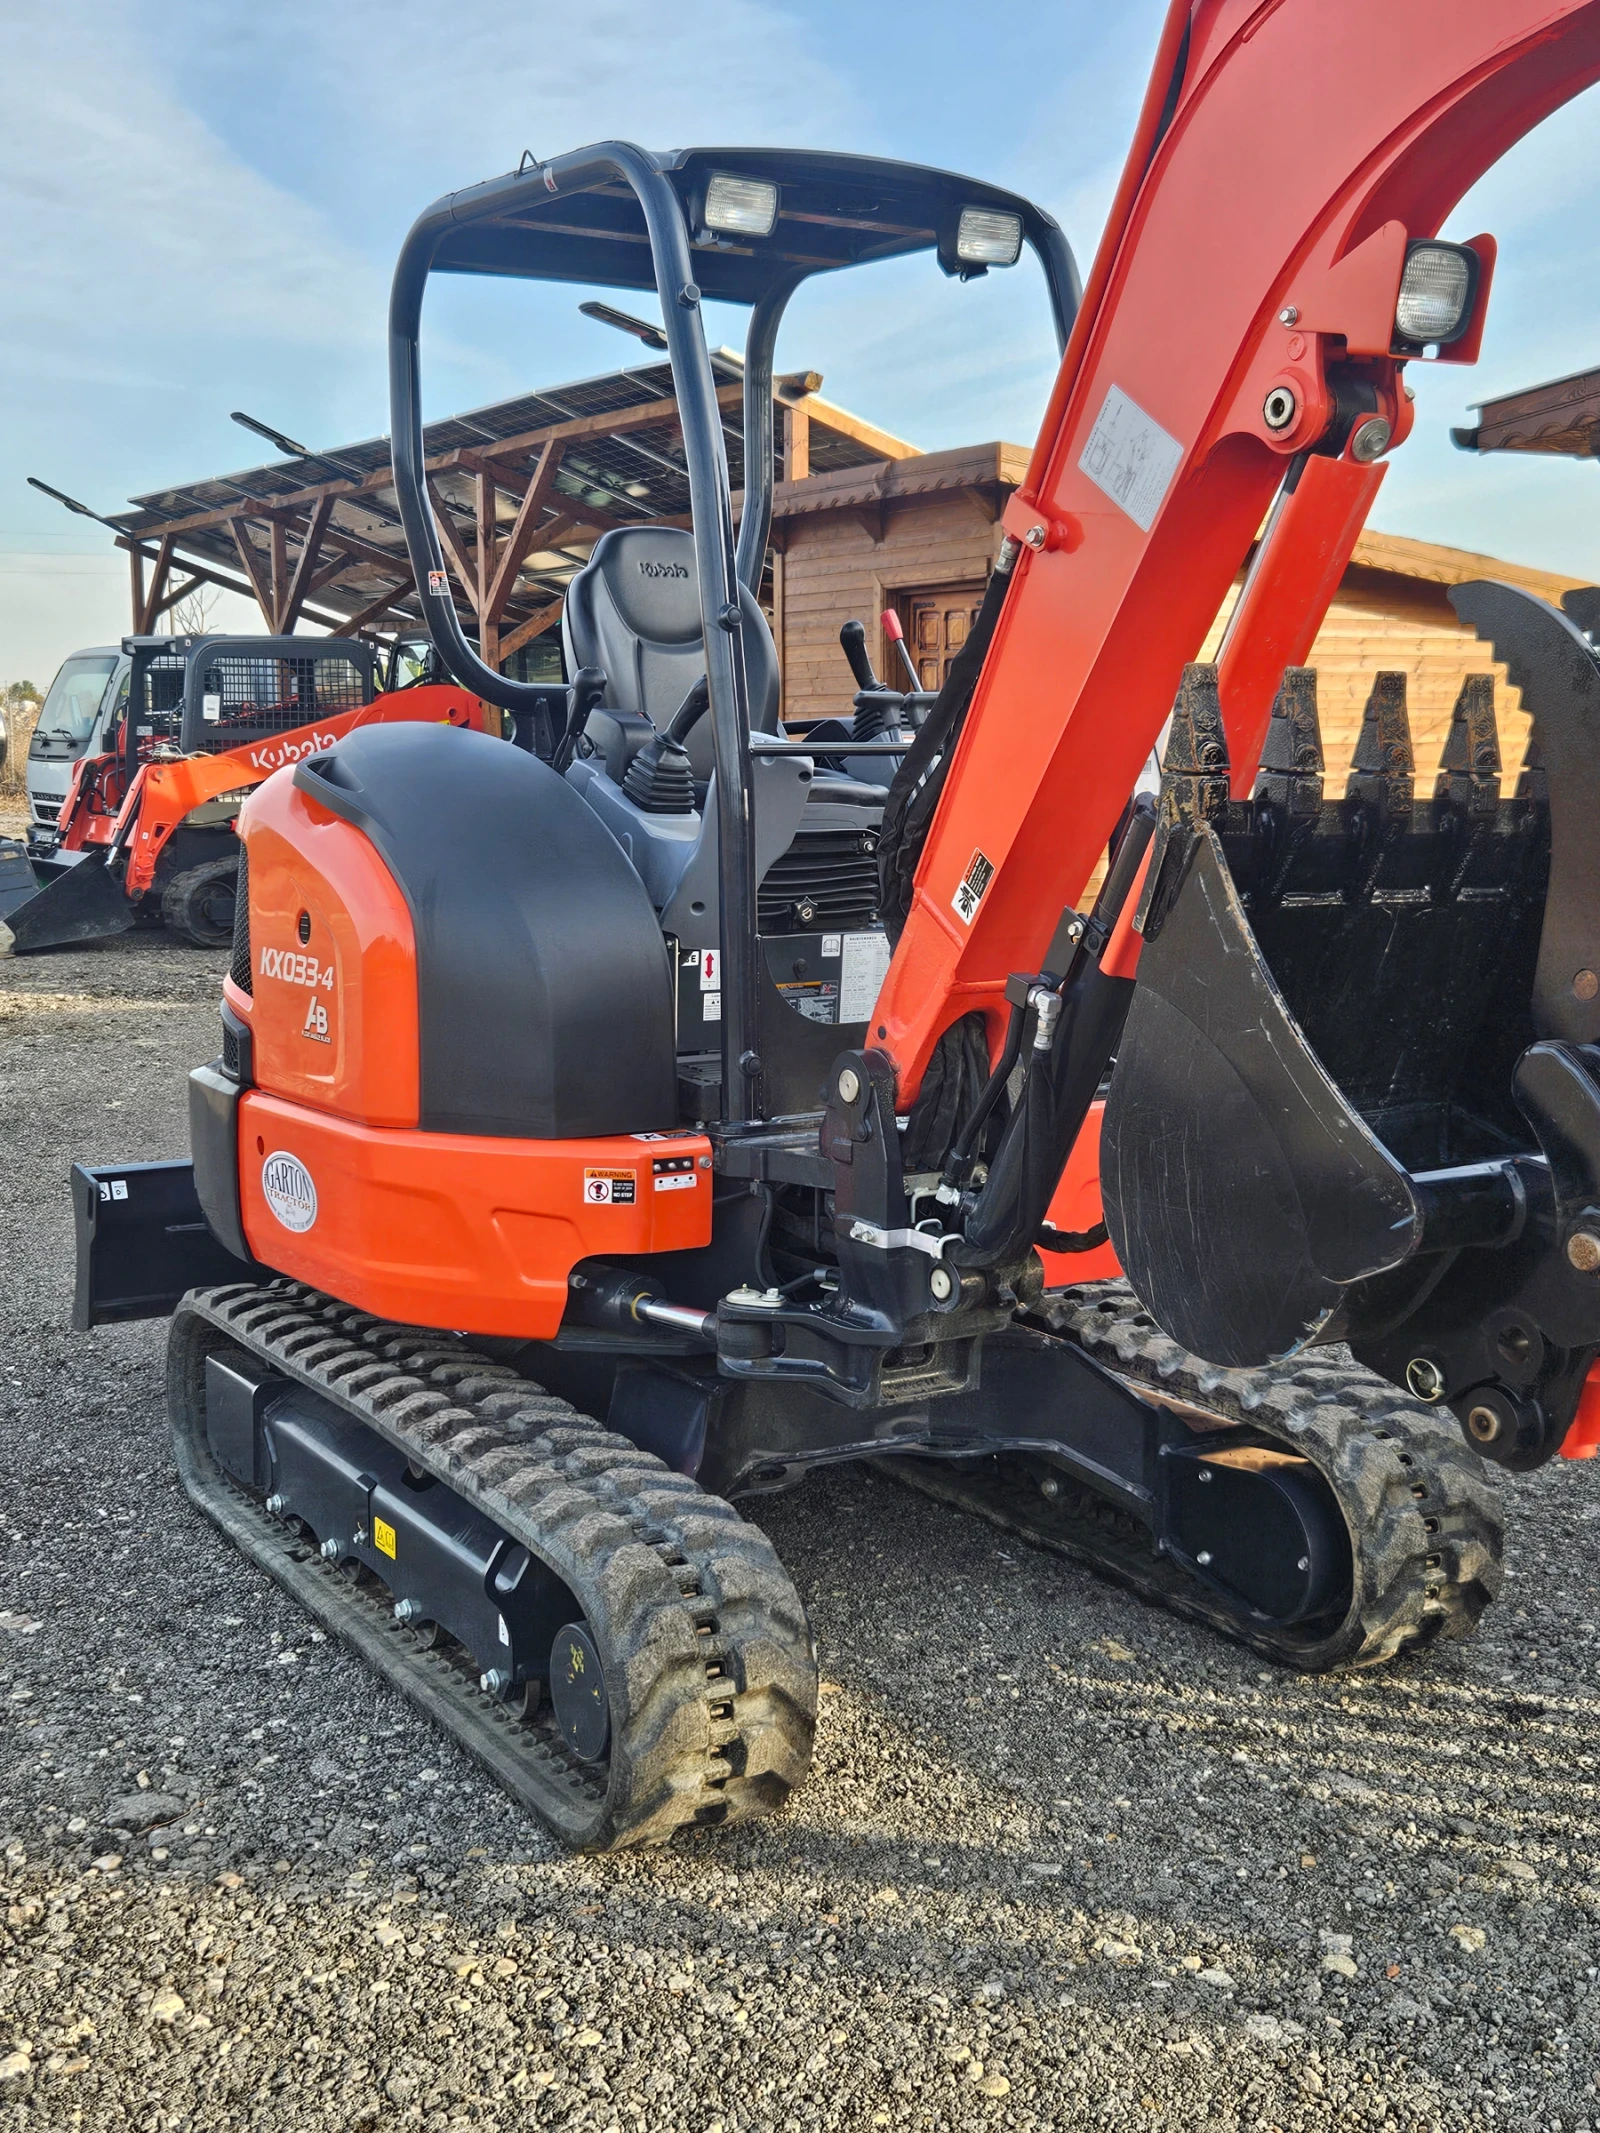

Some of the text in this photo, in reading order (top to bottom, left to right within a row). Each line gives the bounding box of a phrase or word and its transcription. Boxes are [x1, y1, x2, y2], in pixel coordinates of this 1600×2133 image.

[639, 562, 688, 578] Kubota
[251, 732, 336, 769] Kubota
[260, 946, 334, 991] KX033-4
[267, 1162, 311, 1202] GARTON
[598, 1171, 633, 1179] WARNING
[268, 1188, 311, 1212] TRACTOR
